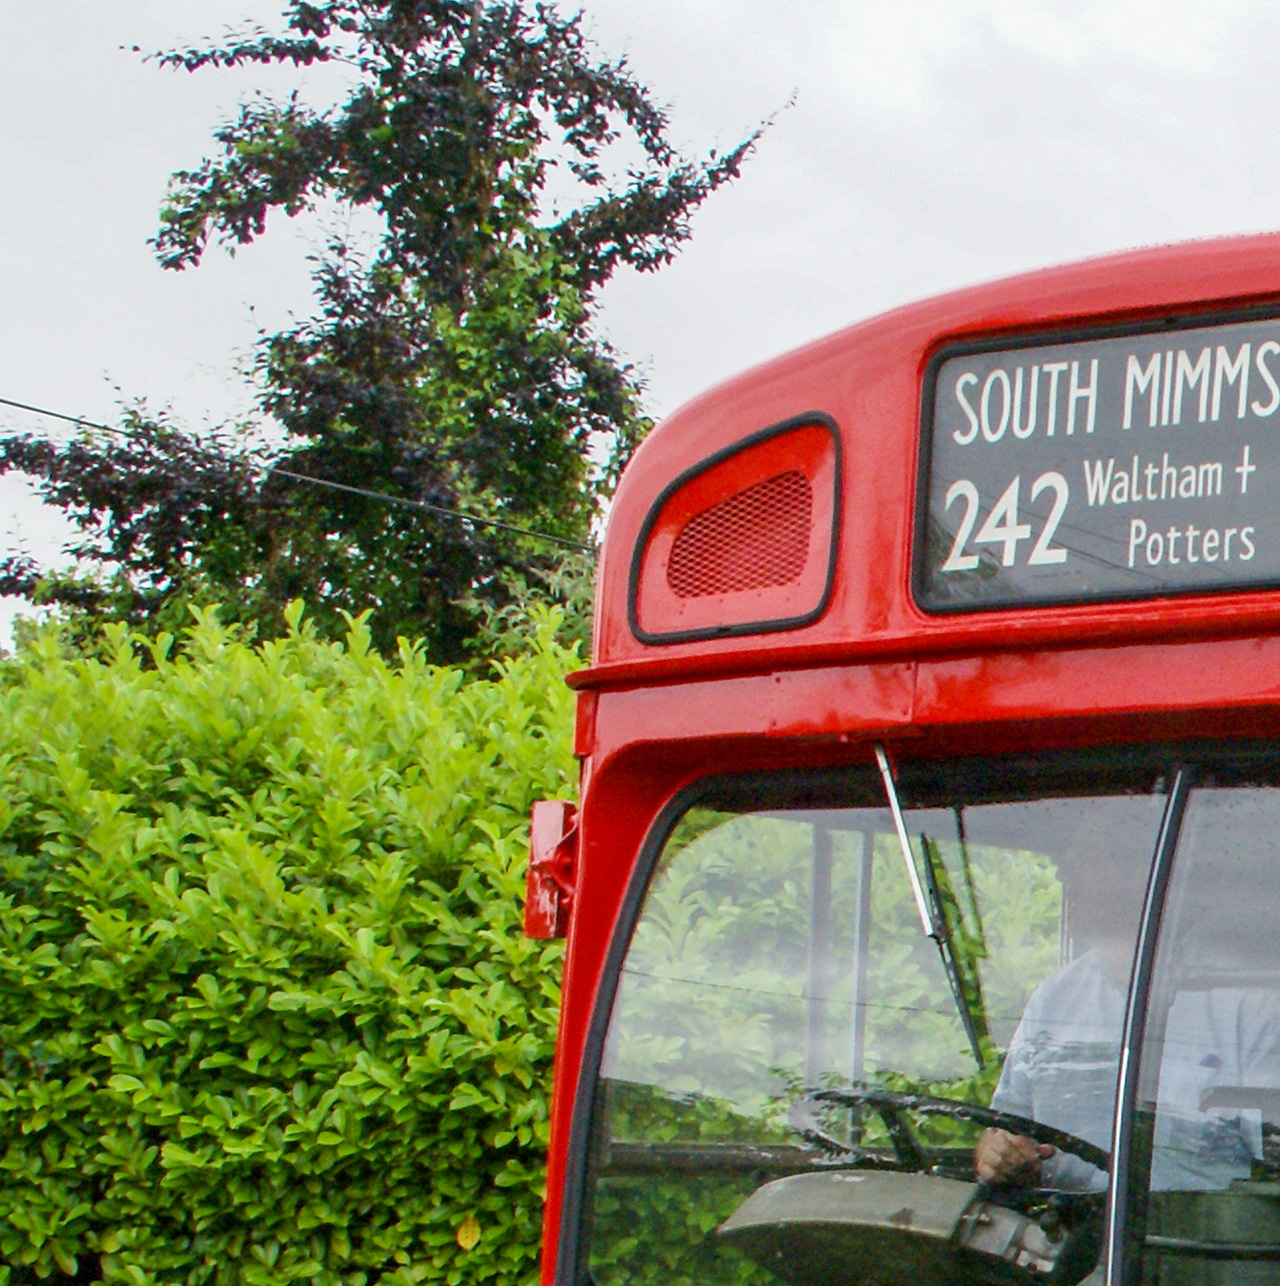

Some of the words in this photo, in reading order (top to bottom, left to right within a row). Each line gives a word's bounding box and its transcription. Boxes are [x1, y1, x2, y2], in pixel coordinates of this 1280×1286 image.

[953, 359, 1100, 445] SOUTH
[1083, 453, 1223, 507] Waltham
[941, 471, 1070, 573] 242
[1128, 518, 1256, 568] Potters
